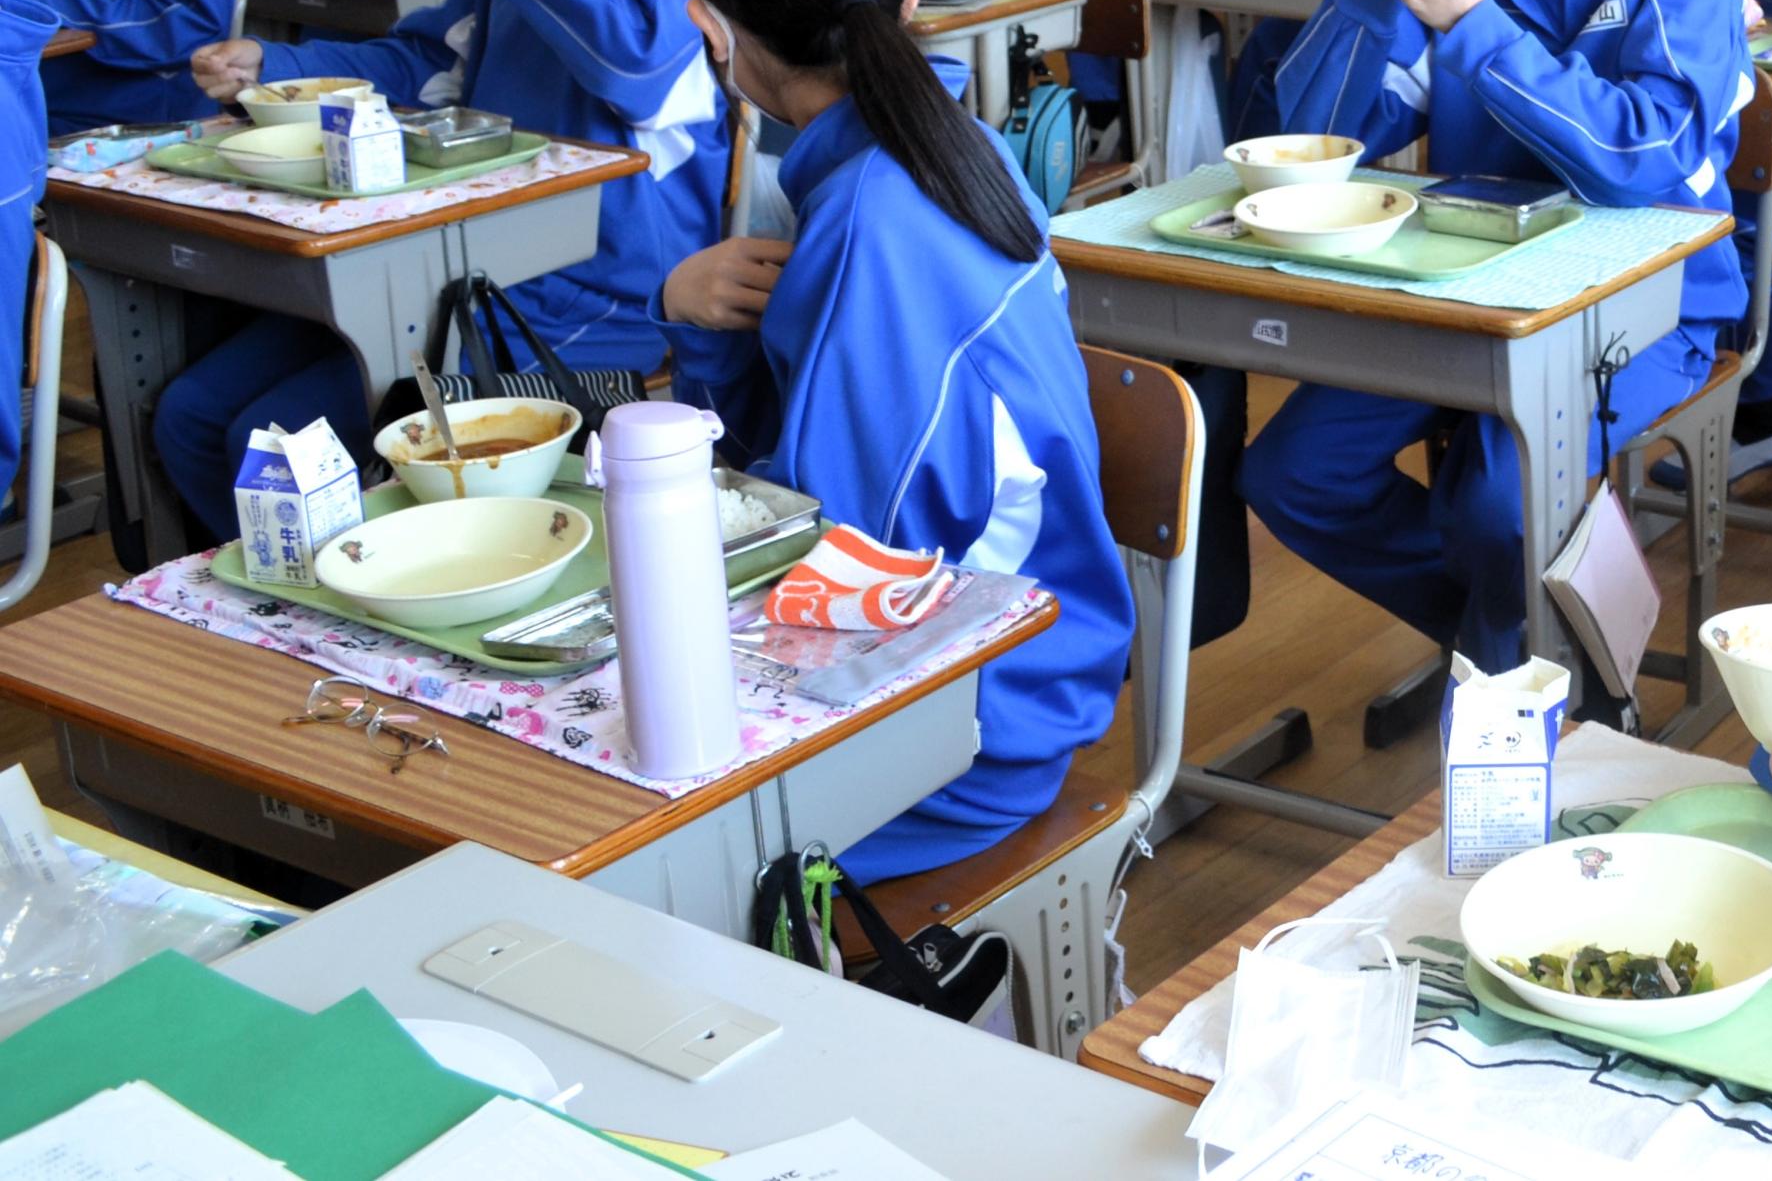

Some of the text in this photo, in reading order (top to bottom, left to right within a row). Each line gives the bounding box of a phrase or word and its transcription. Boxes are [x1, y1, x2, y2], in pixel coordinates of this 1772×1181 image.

[280, 527, 299, 563] 牛乳
[1383, 1144, 1487, 1181] 京都の
